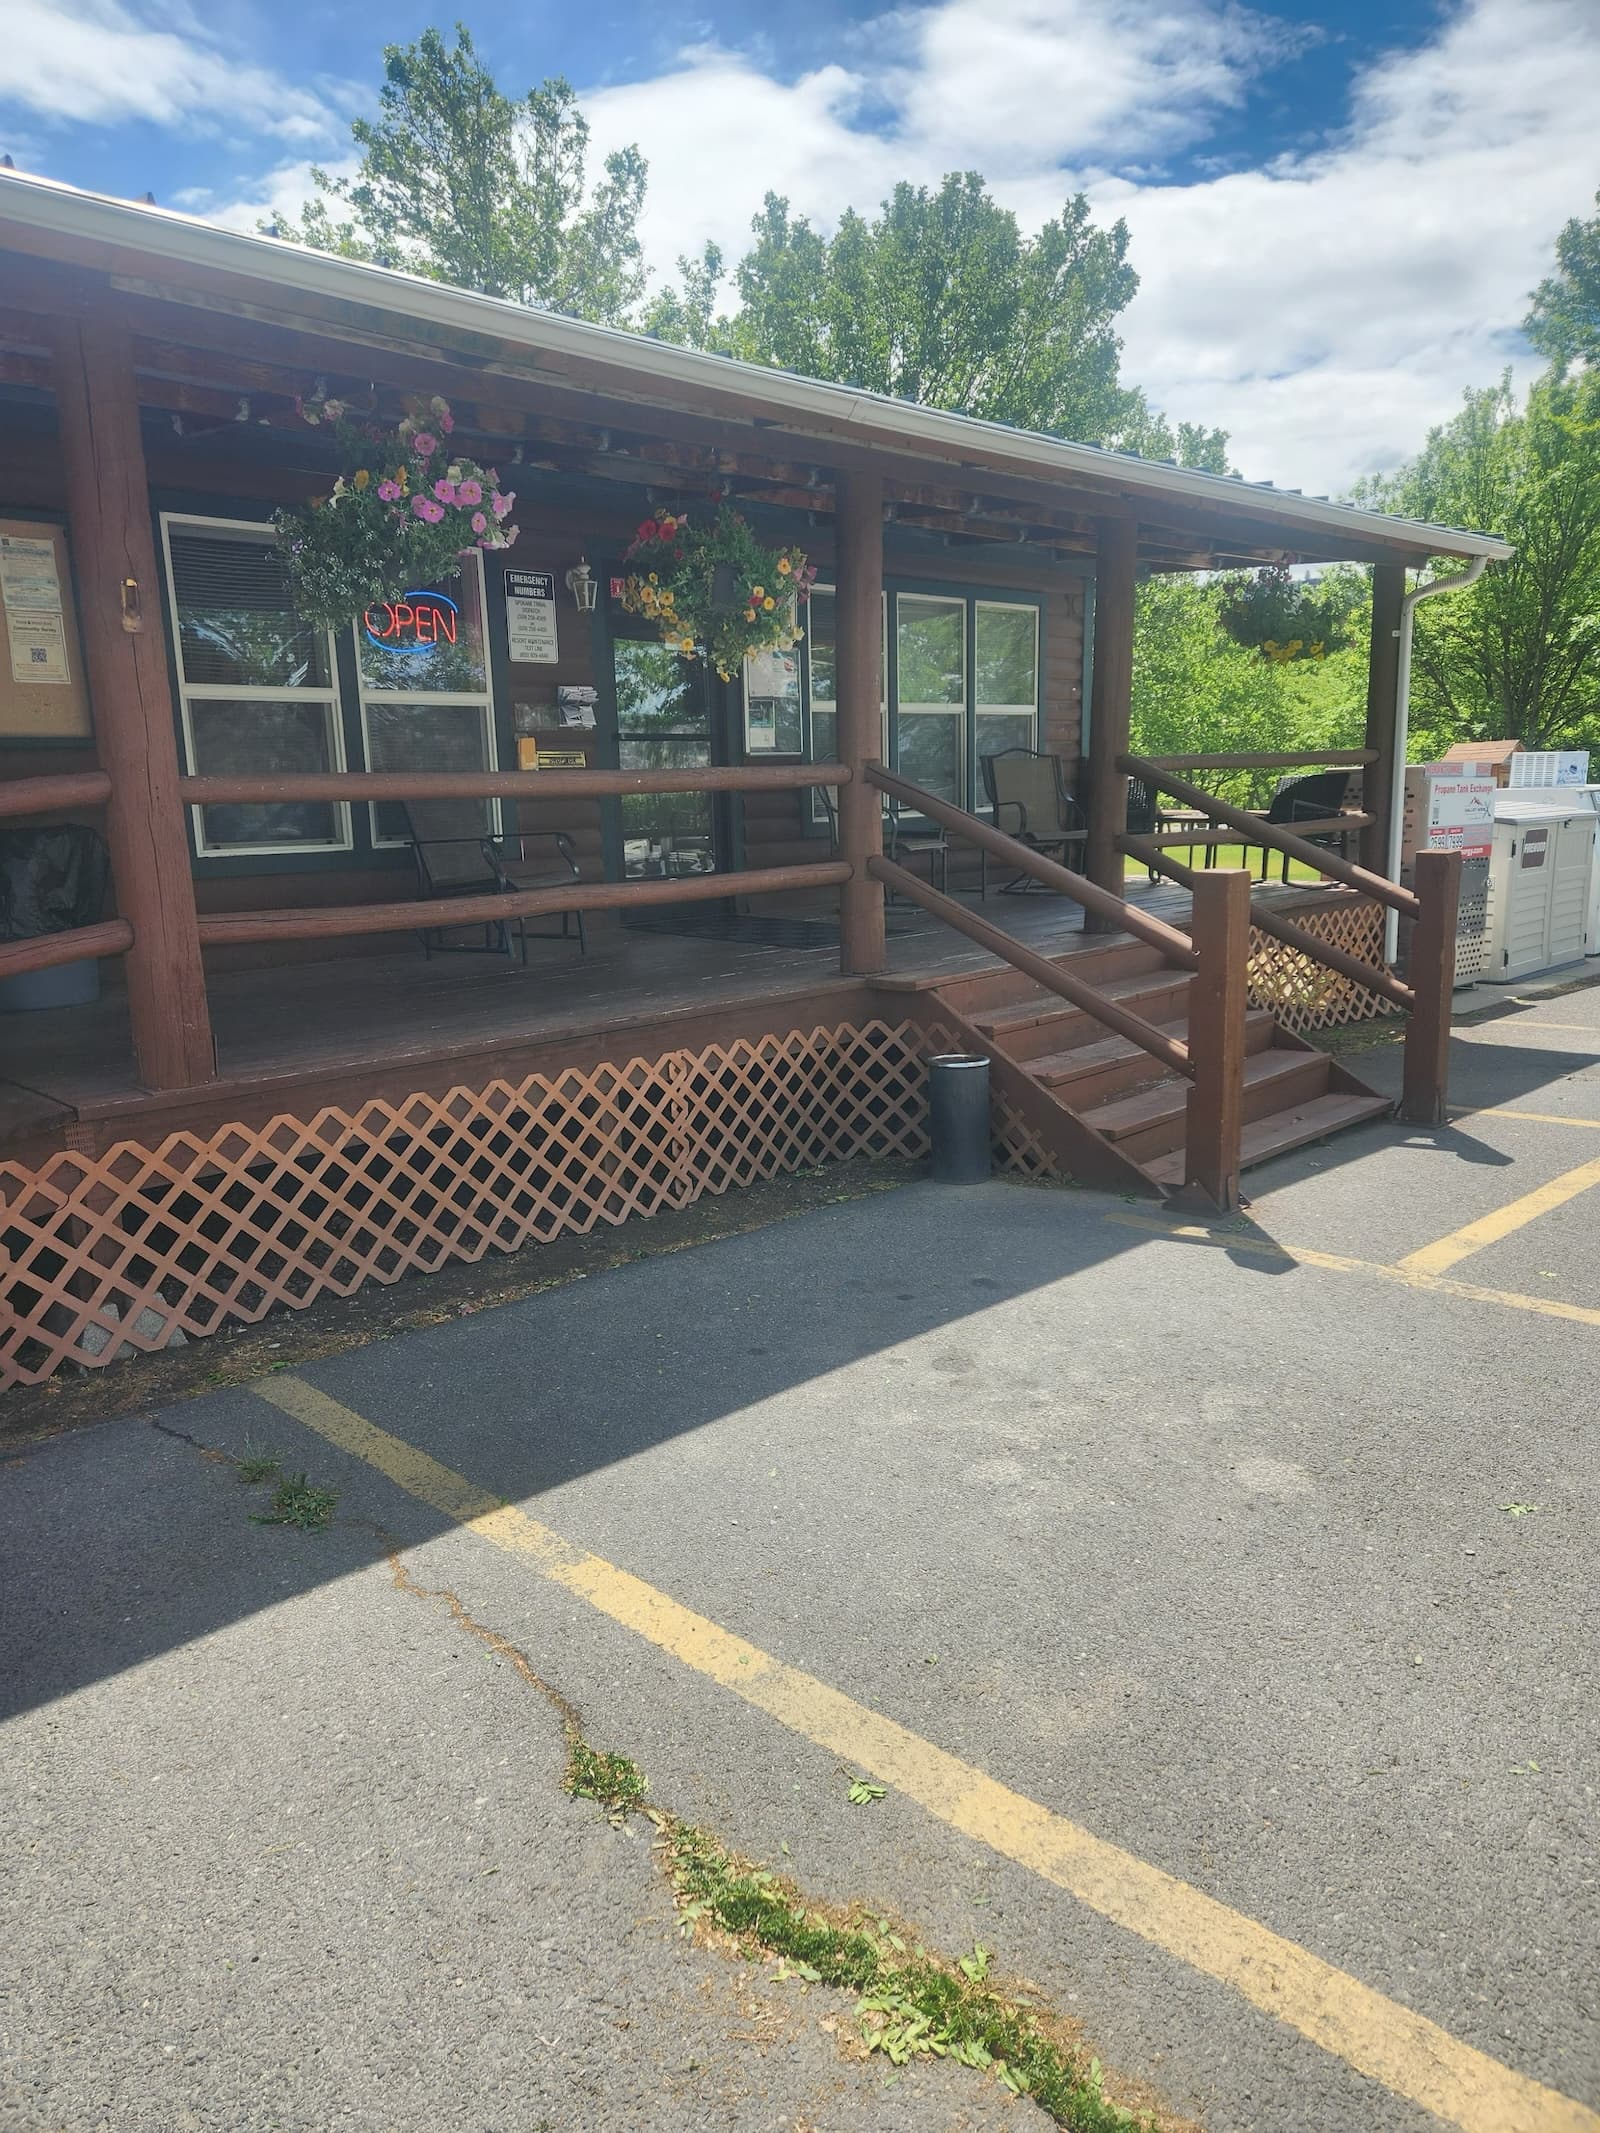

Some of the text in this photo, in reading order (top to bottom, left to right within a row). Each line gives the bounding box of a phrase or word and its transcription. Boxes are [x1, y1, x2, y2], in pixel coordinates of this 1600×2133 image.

[509, 574, 548, 586] EMERGENCY
[514, 586, 545, 597] NUMBERS
[364, 601, 456, 644] OPEN
[1434, 783, 1494, 795] Propane Tank Exchange
[1525, 841, 1546, 854] FIREWOOD
